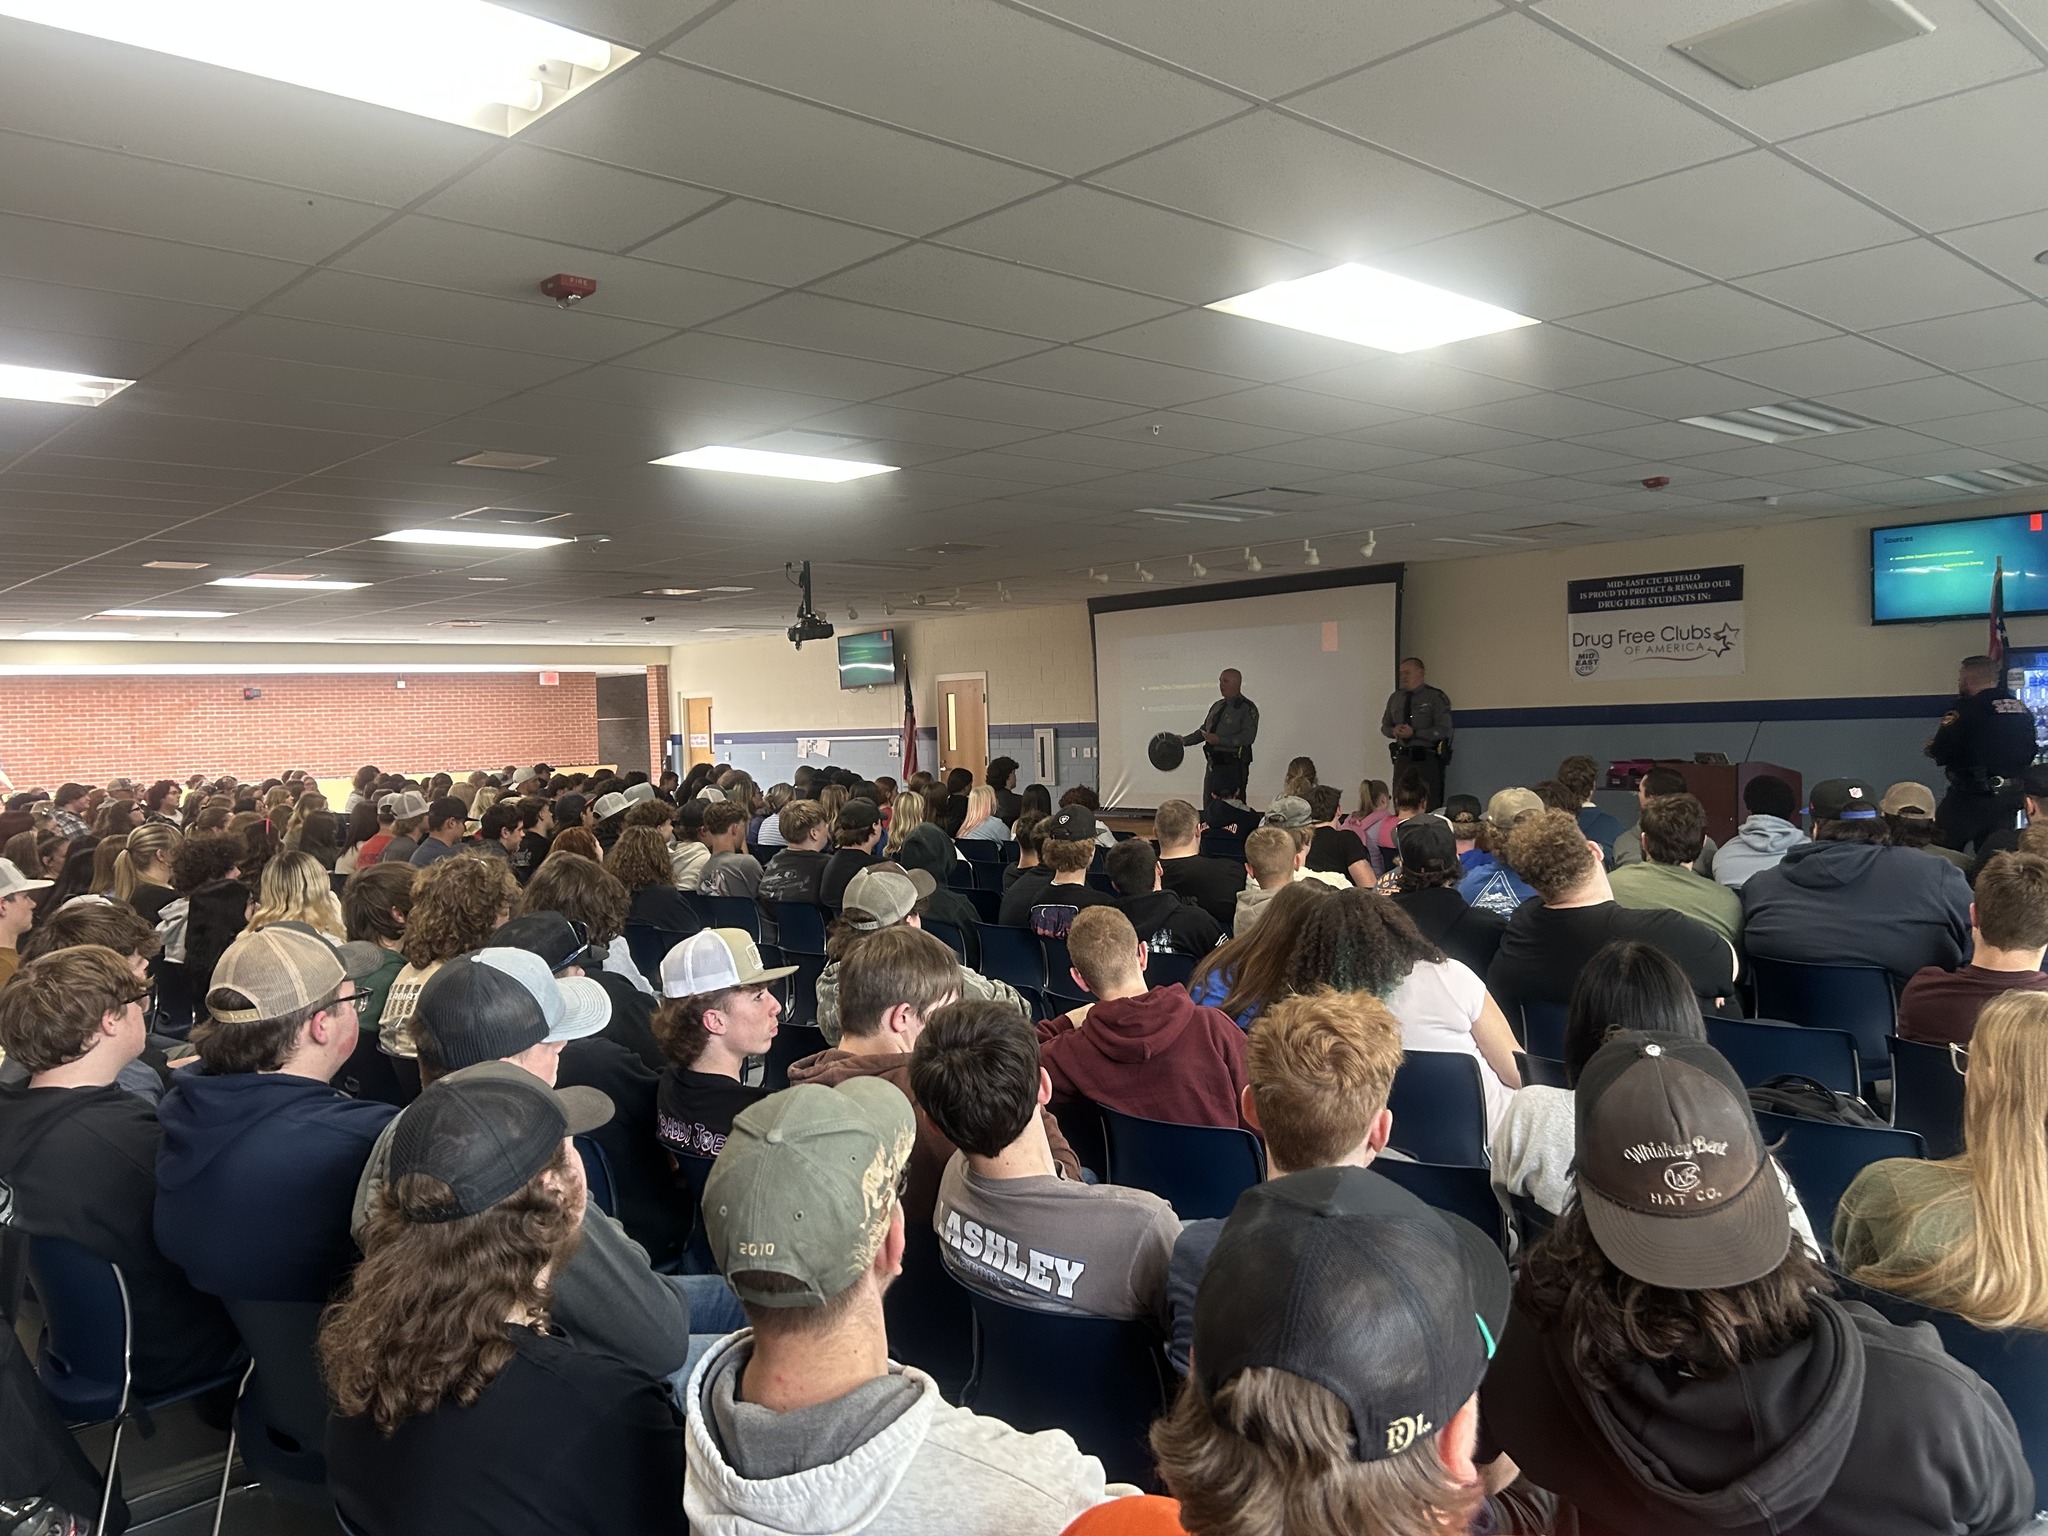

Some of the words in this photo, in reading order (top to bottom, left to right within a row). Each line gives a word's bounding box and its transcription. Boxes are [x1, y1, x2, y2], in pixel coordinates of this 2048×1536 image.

[1580, 592, 1588, 600] IS
[1588, 589, 1616, 599] PROUD
[1617, 588, 1628, 597] TO
[1629, 585, 1667, 594] PROTECT
[1667, 584, 1674, 592] &
[1675, 581, 1711, 592] REWARD
[1712, 579, 1731, 589] OUR
[1606, 579, 1645, 589] MID-EAST
[1646, 577, 1663, 585] CTC
[1664, 573, 1701, 584] BUFFALO
[1598, 600, 1624, 609] DRUG
[1625, 597, 1647, 607] FREE
[1648, 593, 1696, 605] STUDENTS
[1697, 591, 1711, 600] IN:
[1573, 632, 1613, 649] Drug
[1618, 629, 1655, 645] Free
[1661, 624, 1711, 642] Clubs
[1624, 645, 1641, 656] OF
[1646, 642, 1705, 655] AMERICA
[658, 1110, 692, 1144] RABBY
[1623, 1142, 1693, 1164] Whiskey
[1692, 1135, 1728, 1156] Bent
[1650, 1192, 1687, 1206] HAT
[1695, 1187, 1722, 1202] CO.
[739, 1242, 775, 1257] 2010
